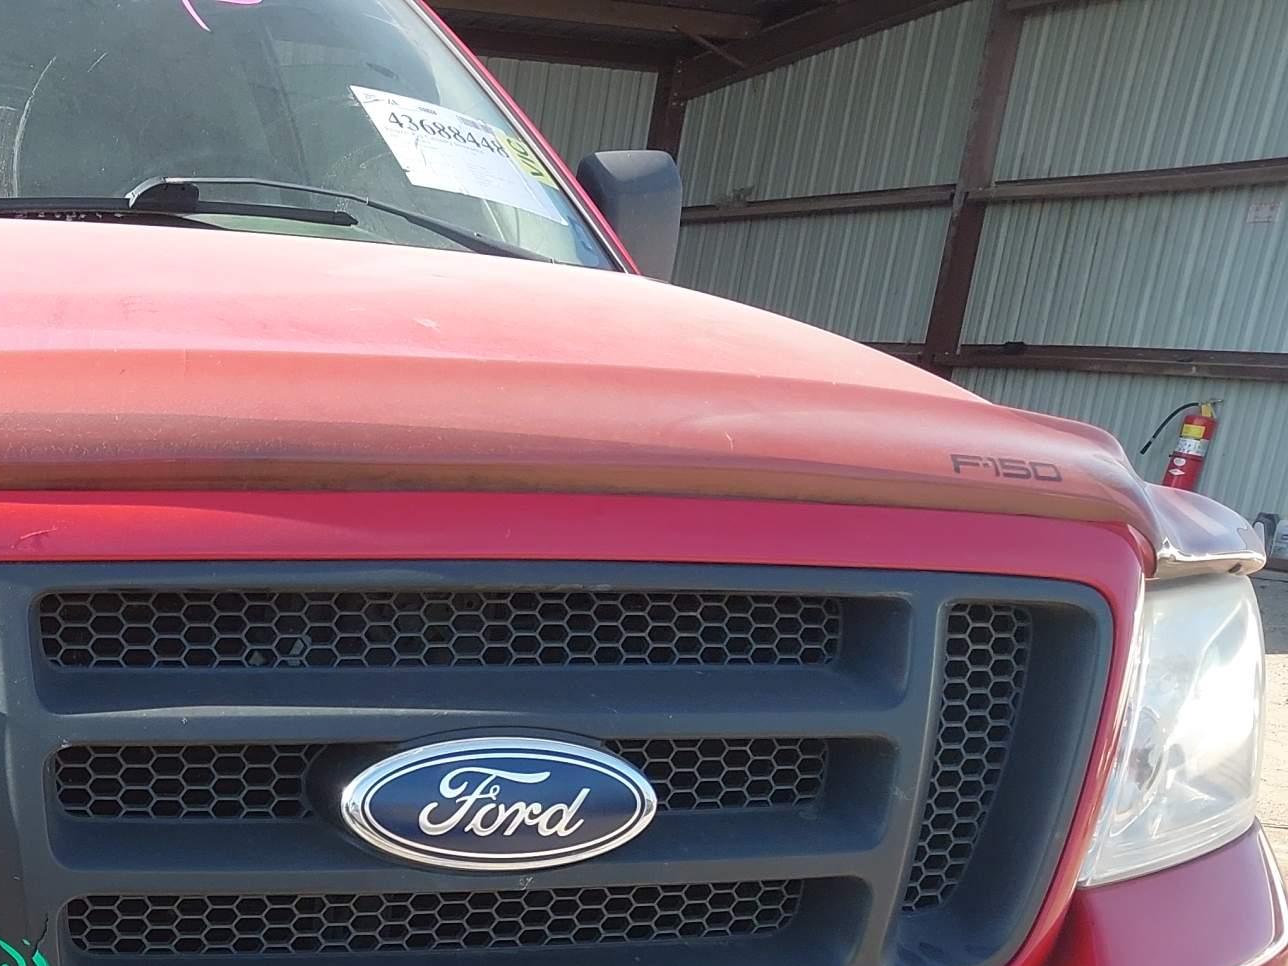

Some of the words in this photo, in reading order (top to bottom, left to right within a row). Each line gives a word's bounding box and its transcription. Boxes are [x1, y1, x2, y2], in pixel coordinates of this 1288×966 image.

[388, 111, 511, 159] 43688448
[950, 453, 1063, 482] F-150
[418, 766, 591, 837] Ford
